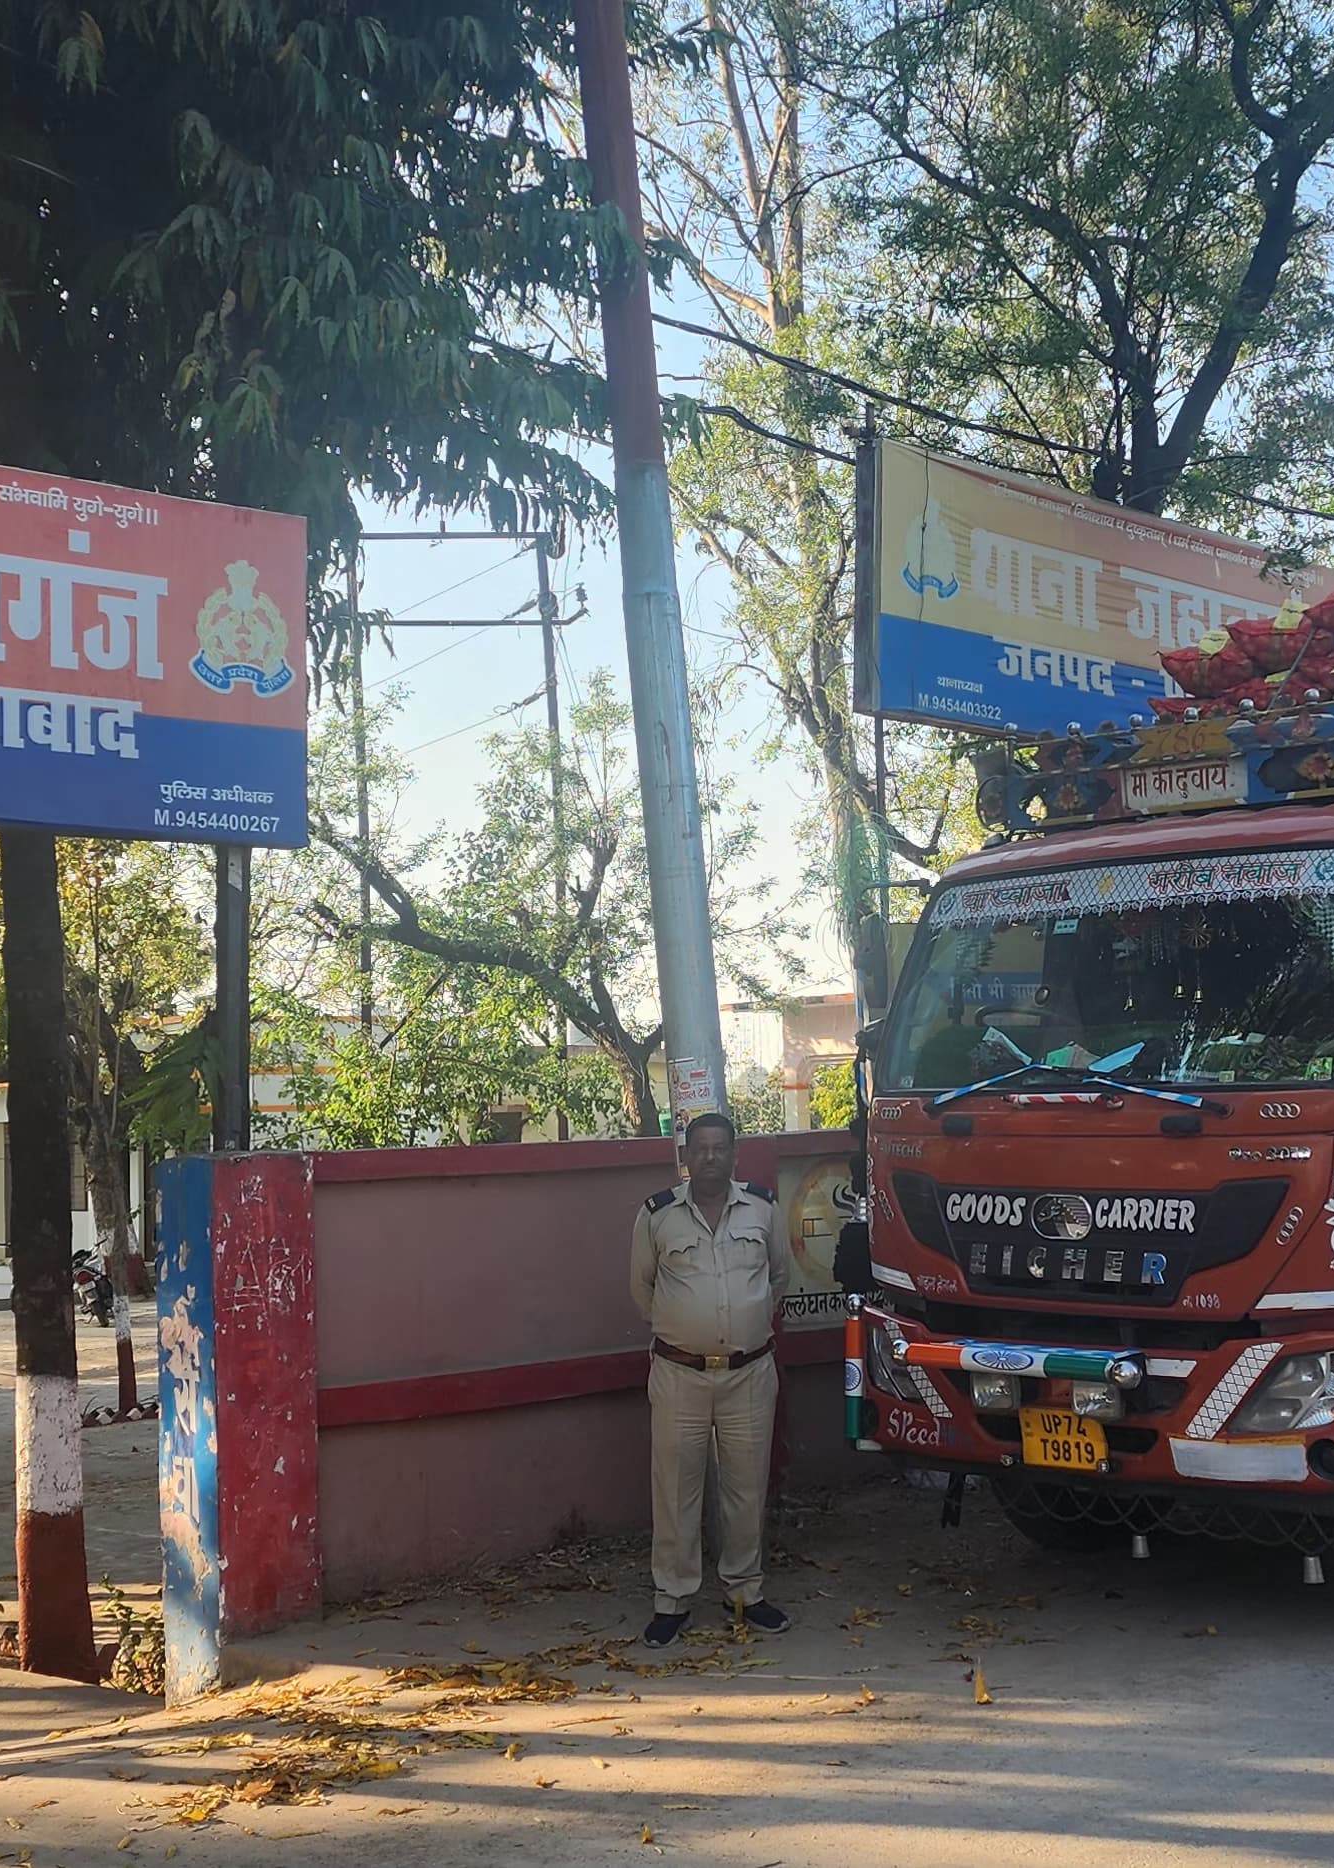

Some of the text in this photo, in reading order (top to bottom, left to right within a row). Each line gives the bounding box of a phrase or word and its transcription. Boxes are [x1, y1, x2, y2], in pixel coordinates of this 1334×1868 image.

[970, 527, 1102, 632] थाना
[992, 635, 1115, 696] जनपद
[918, 692, 1002, 720] M.9454403322
[159, 780, 274, 805] पुलिस अधीक्षक
[154, 807, 280, 832] M.9454400267
[946, 1193, 1197, 1233] GOODS CARRIER
[969, 1243, 1167, 1285] EICHER
[1041, 1413, 1088, 1437] UP74
[1041, 1439, 1095, 1464] T9819
